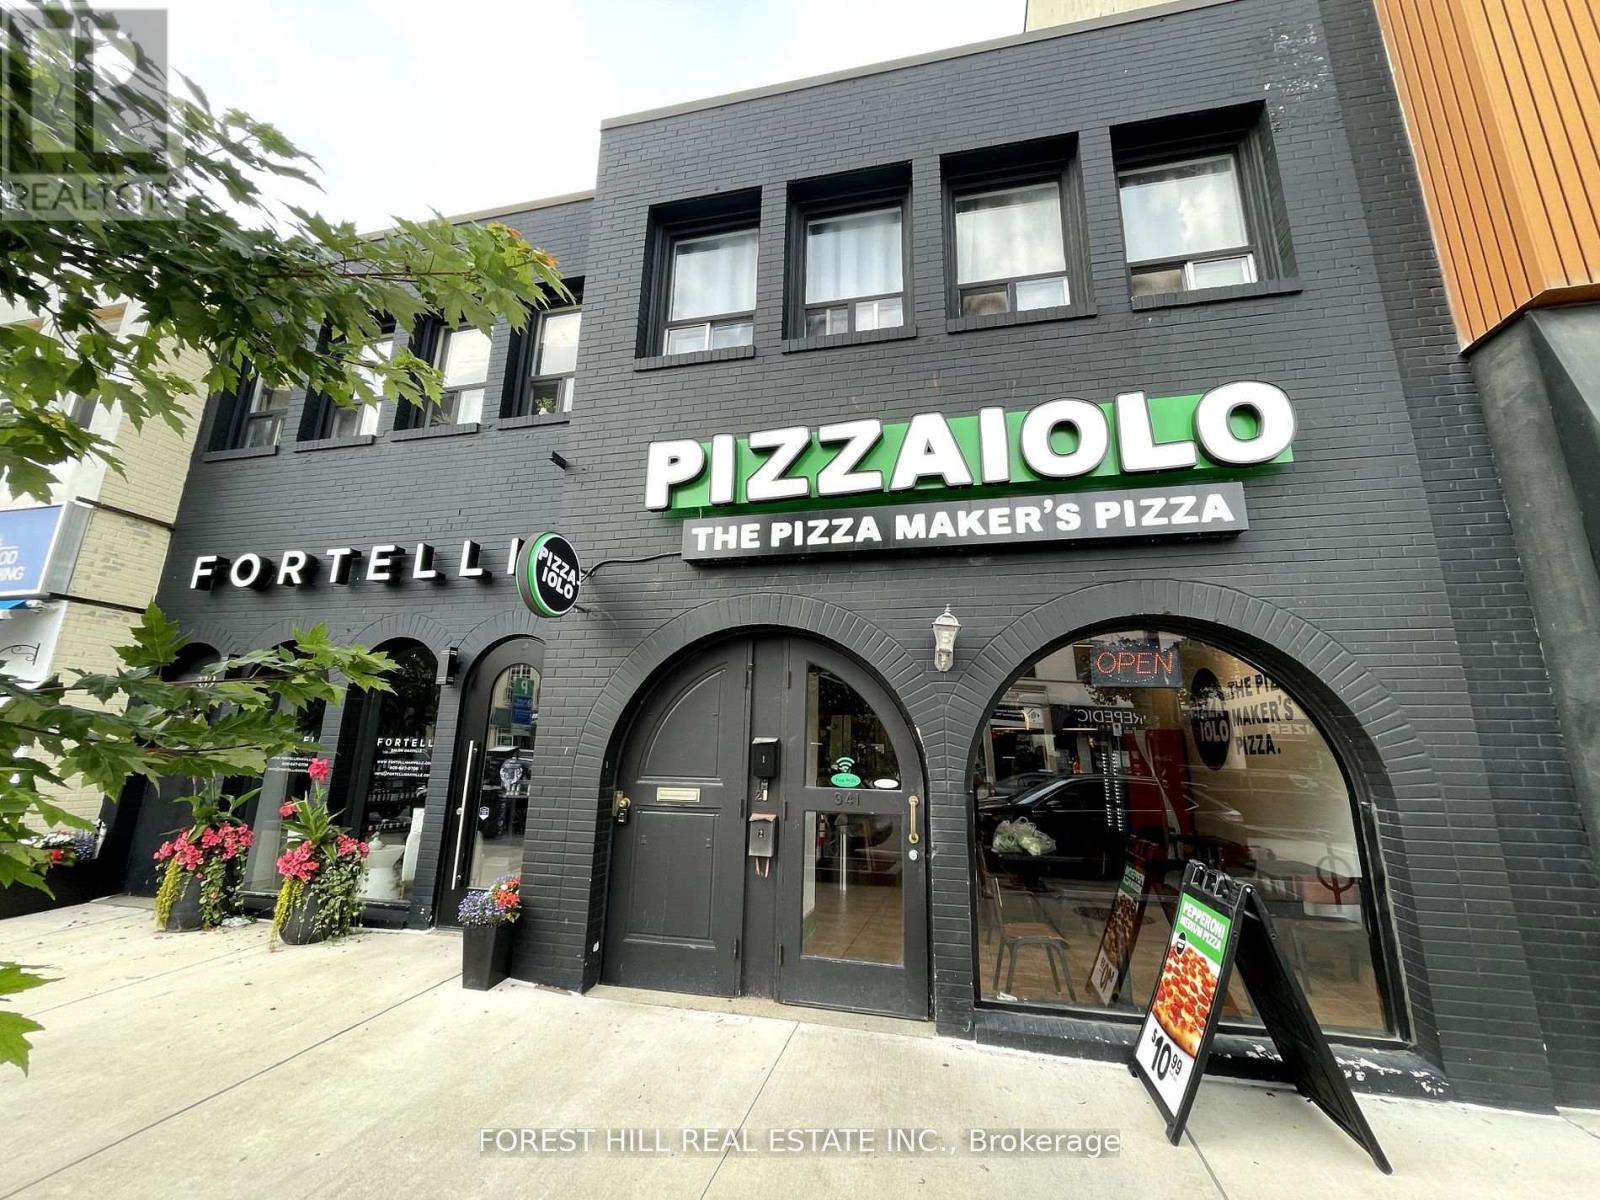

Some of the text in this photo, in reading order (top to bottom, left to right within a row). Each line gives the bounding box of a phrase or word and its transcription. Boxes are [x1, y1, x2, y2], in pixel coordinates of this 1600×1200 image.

[645, 380, 1298, 512] PIZZAIOLO
[691, 492, 1236, 552] THE PIZZA MAKER'S PIZZA
[190, 537, 519, 590] FORTELLI
[541, 566, 574, 600] IOLO
[1096, 651, 1173, 674] OPEN
[1227, 675, 1253, 699] THE
[1231, 695, 1295, 727] MAKER'S
[1200, 719, 1229, 742] IOLO
[834, 791, 861, 807] 341
[1182, 901, 1226, 940] PEPPERONI
[1202, 929, 1221, 953] PIZZA
